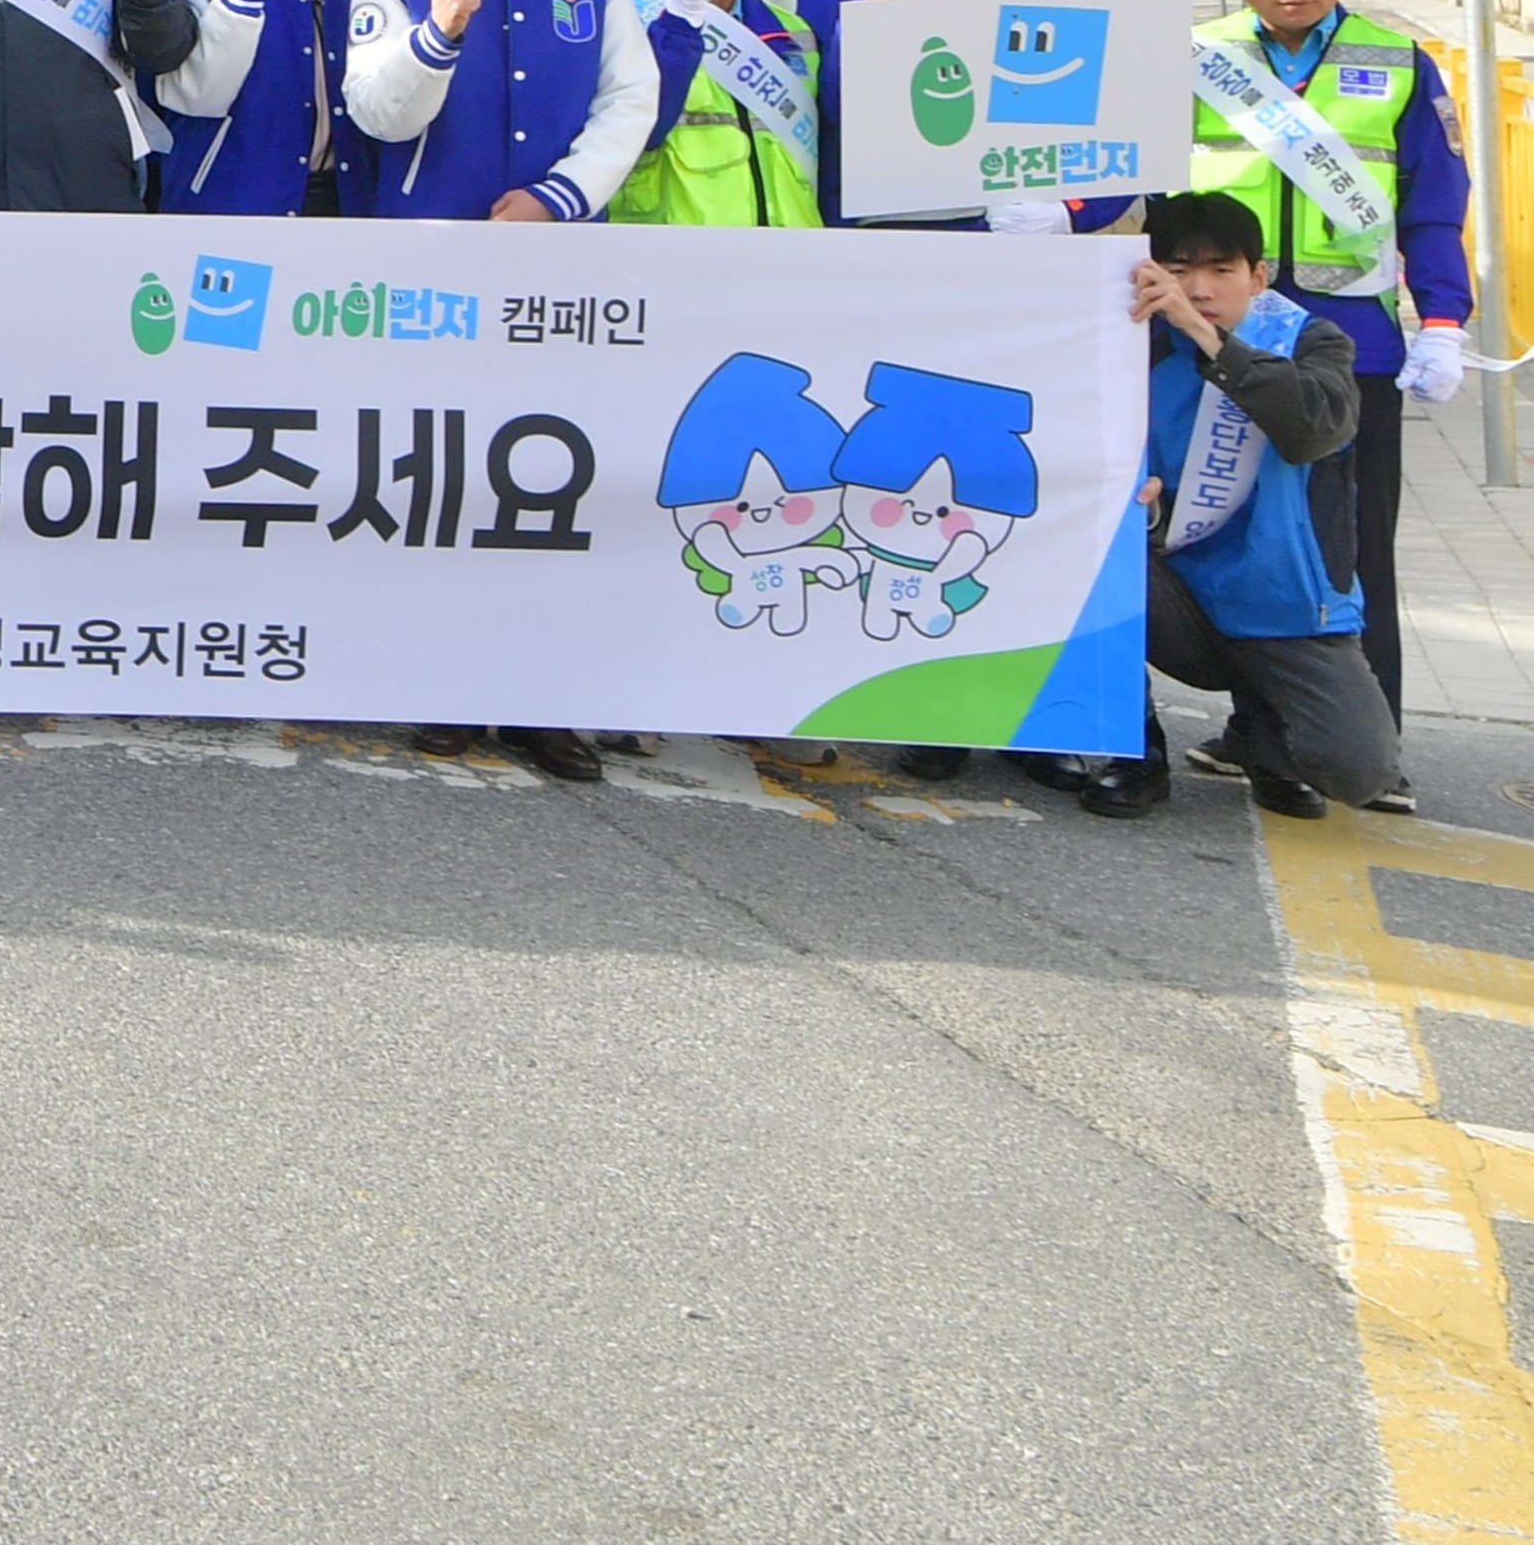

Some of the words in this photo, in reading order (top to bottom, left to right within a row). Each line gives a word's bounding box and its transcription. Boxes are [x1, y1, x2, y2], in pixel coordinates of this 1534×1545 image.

[1304, 142, 1355, 195] 생각해
[1346, 192, 1379, 229] 주세
[291, 280, 480, 341] 아이먼저
[501, 291, 646, 347] 캠페인
[198, 407, 597, 551] 주세요
[750, 564, 784, 592] 성장
[889, 575, 922, 602] 장성
